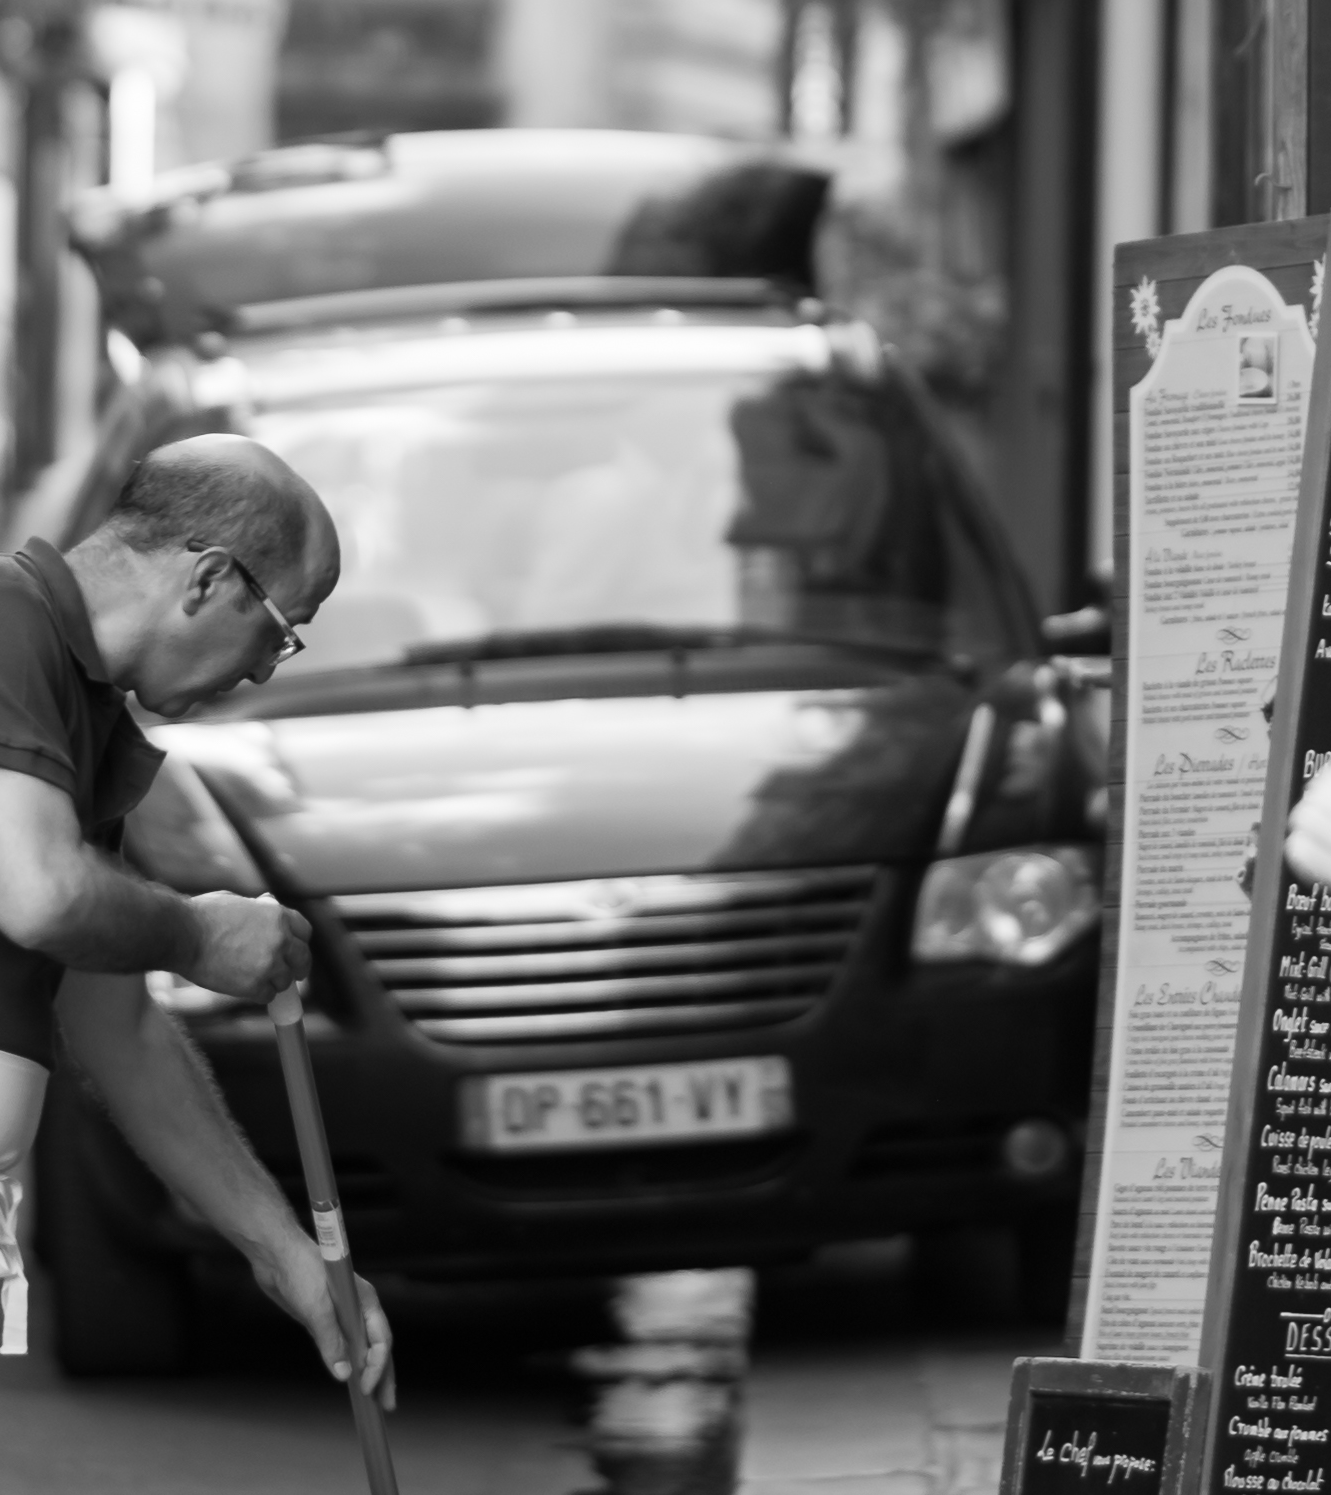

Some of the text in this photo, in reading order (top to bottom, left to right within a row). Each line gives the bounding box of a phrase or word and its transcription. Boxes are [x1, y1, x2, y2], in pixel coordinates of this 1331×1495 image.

[1273, 1006, 1309, 1042] Onglet
[1267, 1061, 1316, 1091] Calamars
[1261, 1124, 1296, 1147] Cuisse
[1298, 1127, 1309, 1147] de
[1255, 1182, 1288, 1211] Penne
[1291, 1183, 1318, 1211] Pasta
[1249, 1240, 1298, 1268] Brochette
[1299, 1248, 1312, 1268] de
[1229, 1416, 1272, 1438] Crumble
[1036, 1430, 1055, 1461] Le
[1224, 1464, 1265, 1489] Mousse
